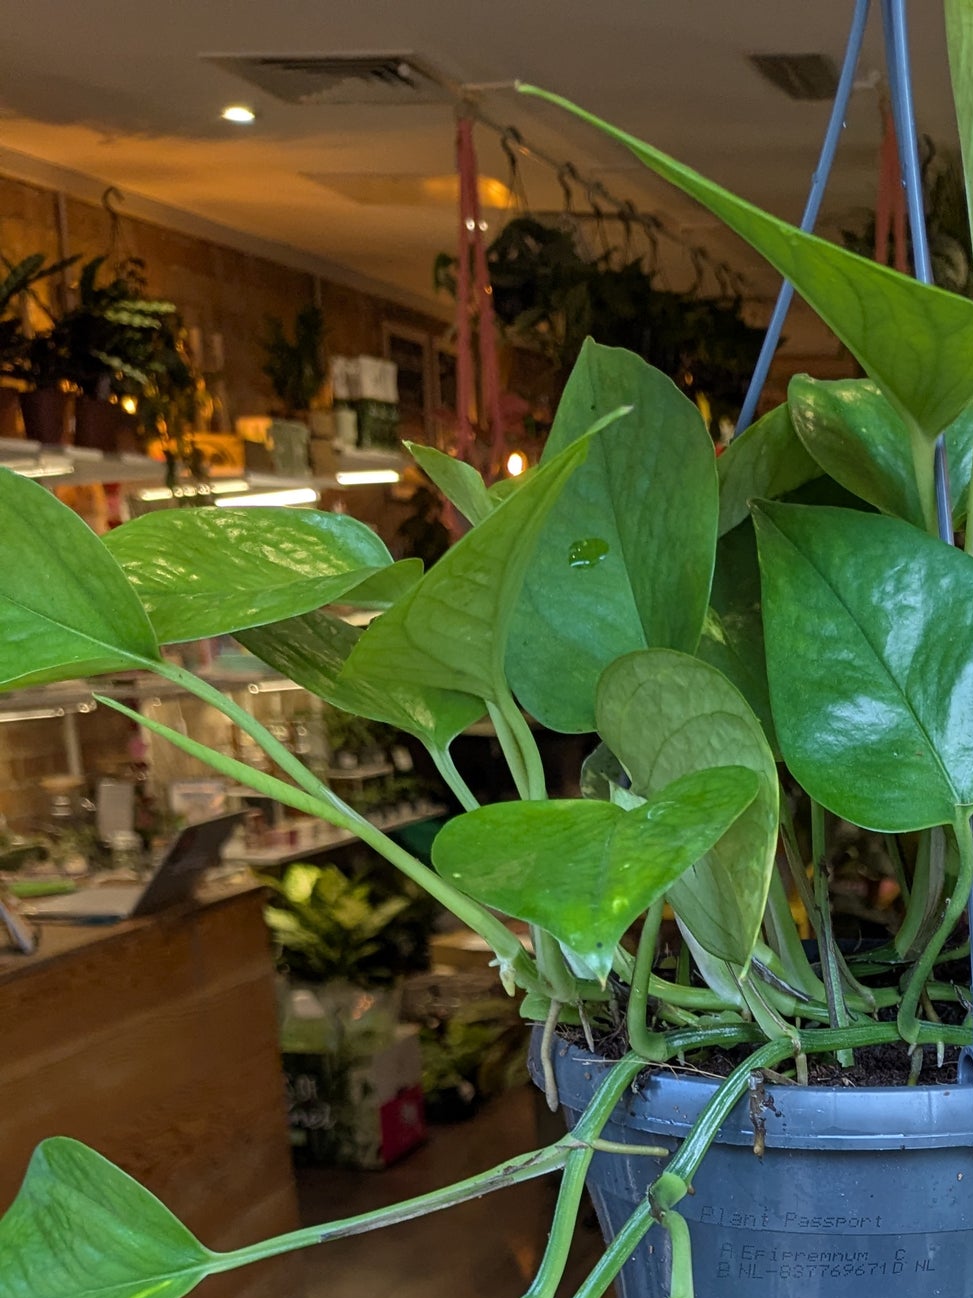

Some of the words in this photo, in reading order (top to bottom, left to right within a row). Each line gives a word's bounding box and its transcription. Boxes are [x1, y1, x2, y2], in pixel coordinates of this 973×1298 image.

[698, 1204, 769, 1227] Plant
[784, 1211, 883, 1228] Passport
[720, 1241, 735, 1259] A
[895, 1248, 906, 1262] C
[716, 1261, 731, 1279] B
[892, 1261, 904, 1275] D
[914, 1258, 936, 1273] NL
